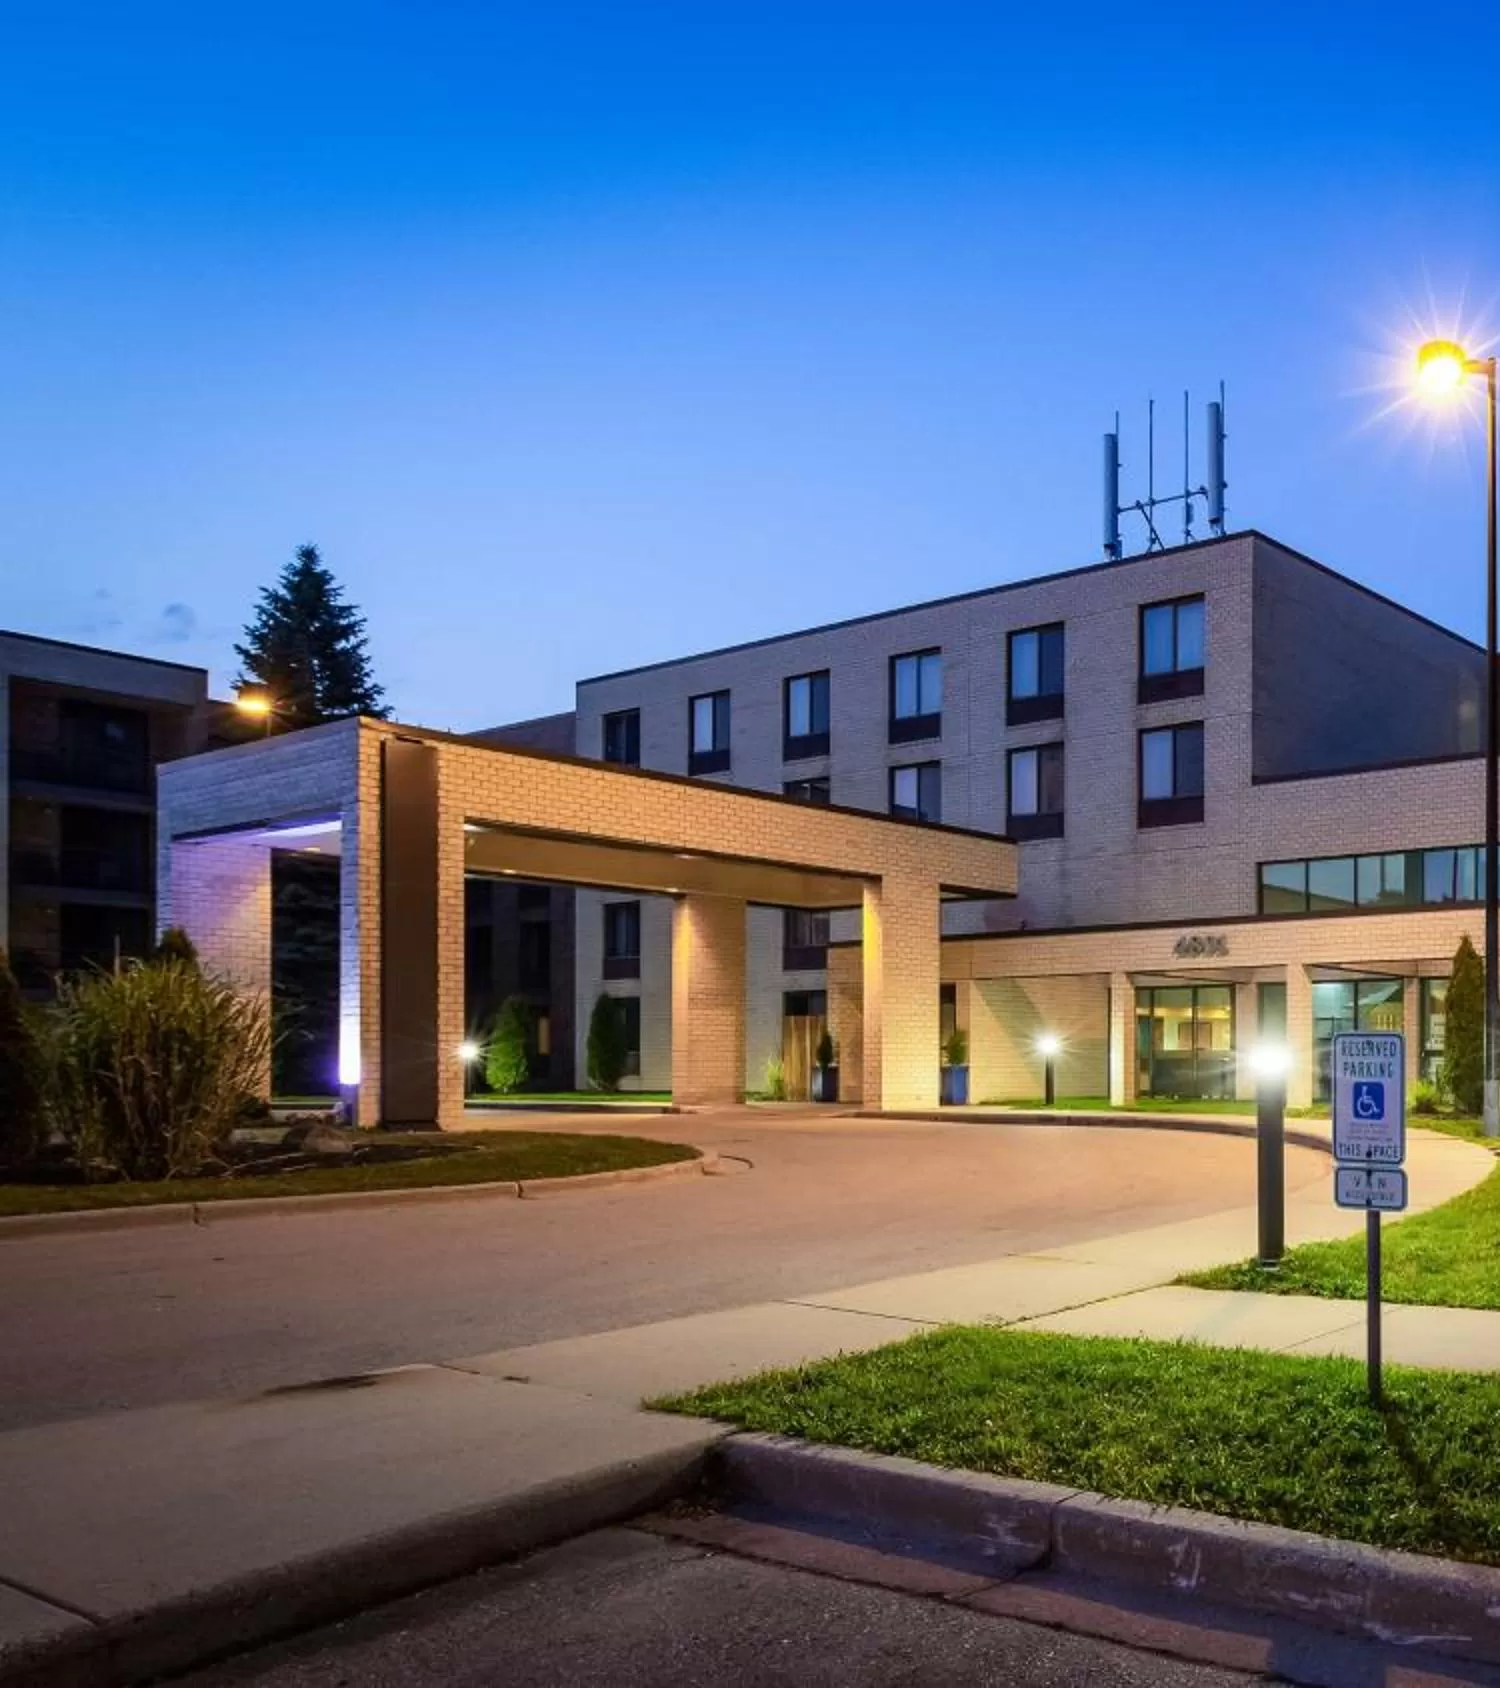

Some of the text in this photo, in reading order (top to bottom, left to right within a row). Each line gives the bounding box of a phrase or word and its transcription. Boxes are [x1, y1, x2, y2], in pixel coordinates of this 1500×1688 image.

[1341, 1040, 1397, 1057] RESERVED
[1343, 1061, 1393, 1079] PARKING
[1339, 1142, 1361, 1157] THIS
